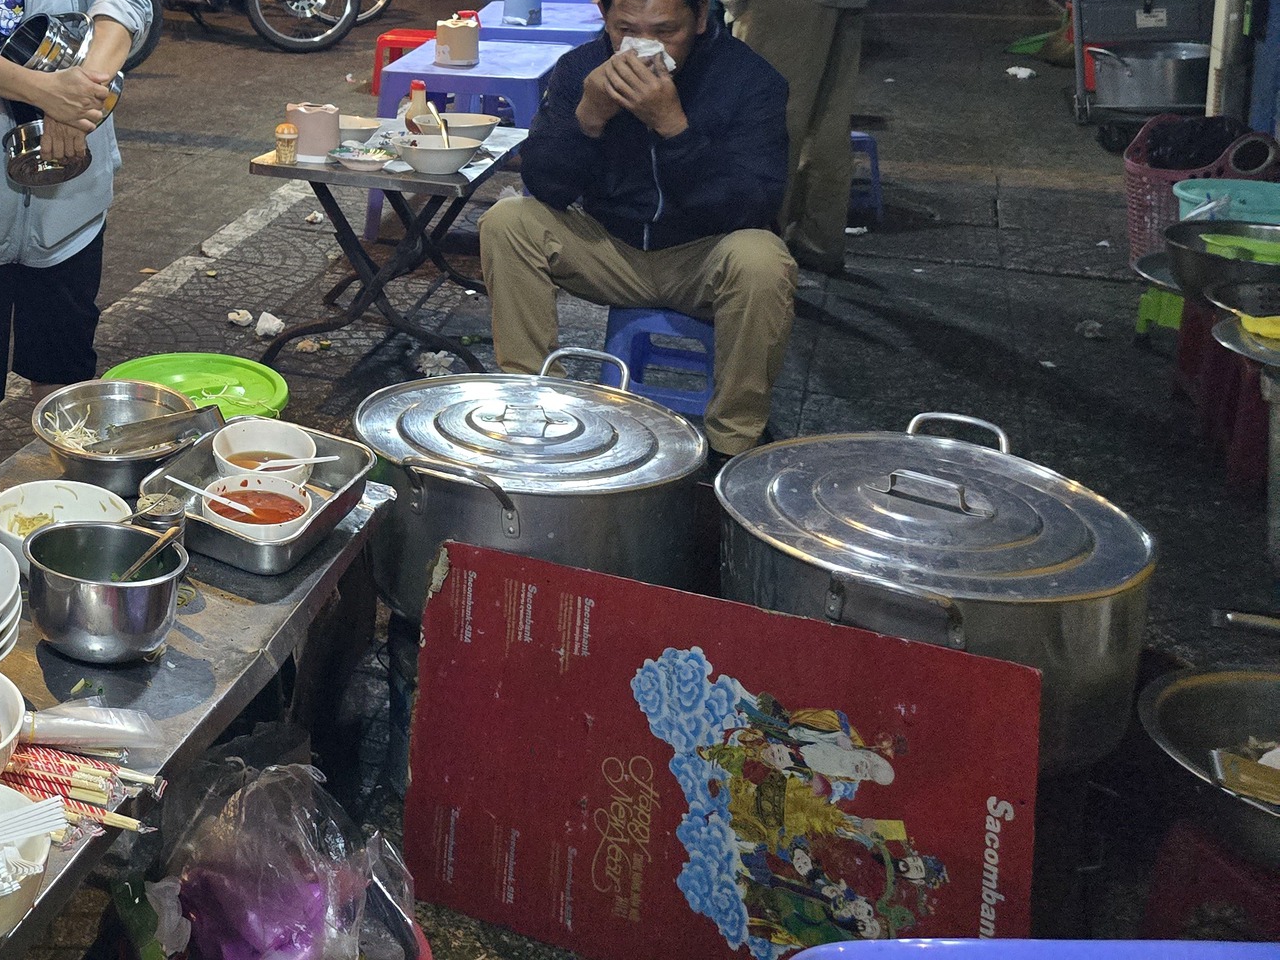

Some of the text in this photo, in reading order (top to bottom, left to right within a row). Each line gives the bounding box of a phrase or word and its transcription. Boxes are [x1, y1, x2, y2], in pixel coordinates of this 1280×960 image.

[523, 584, 538, 644] Sacombank
[581, 597, 596, 657] Sacombank
[627, 755, 661, 863] Happy
[979, 796, 1015, 939] Sacomban
